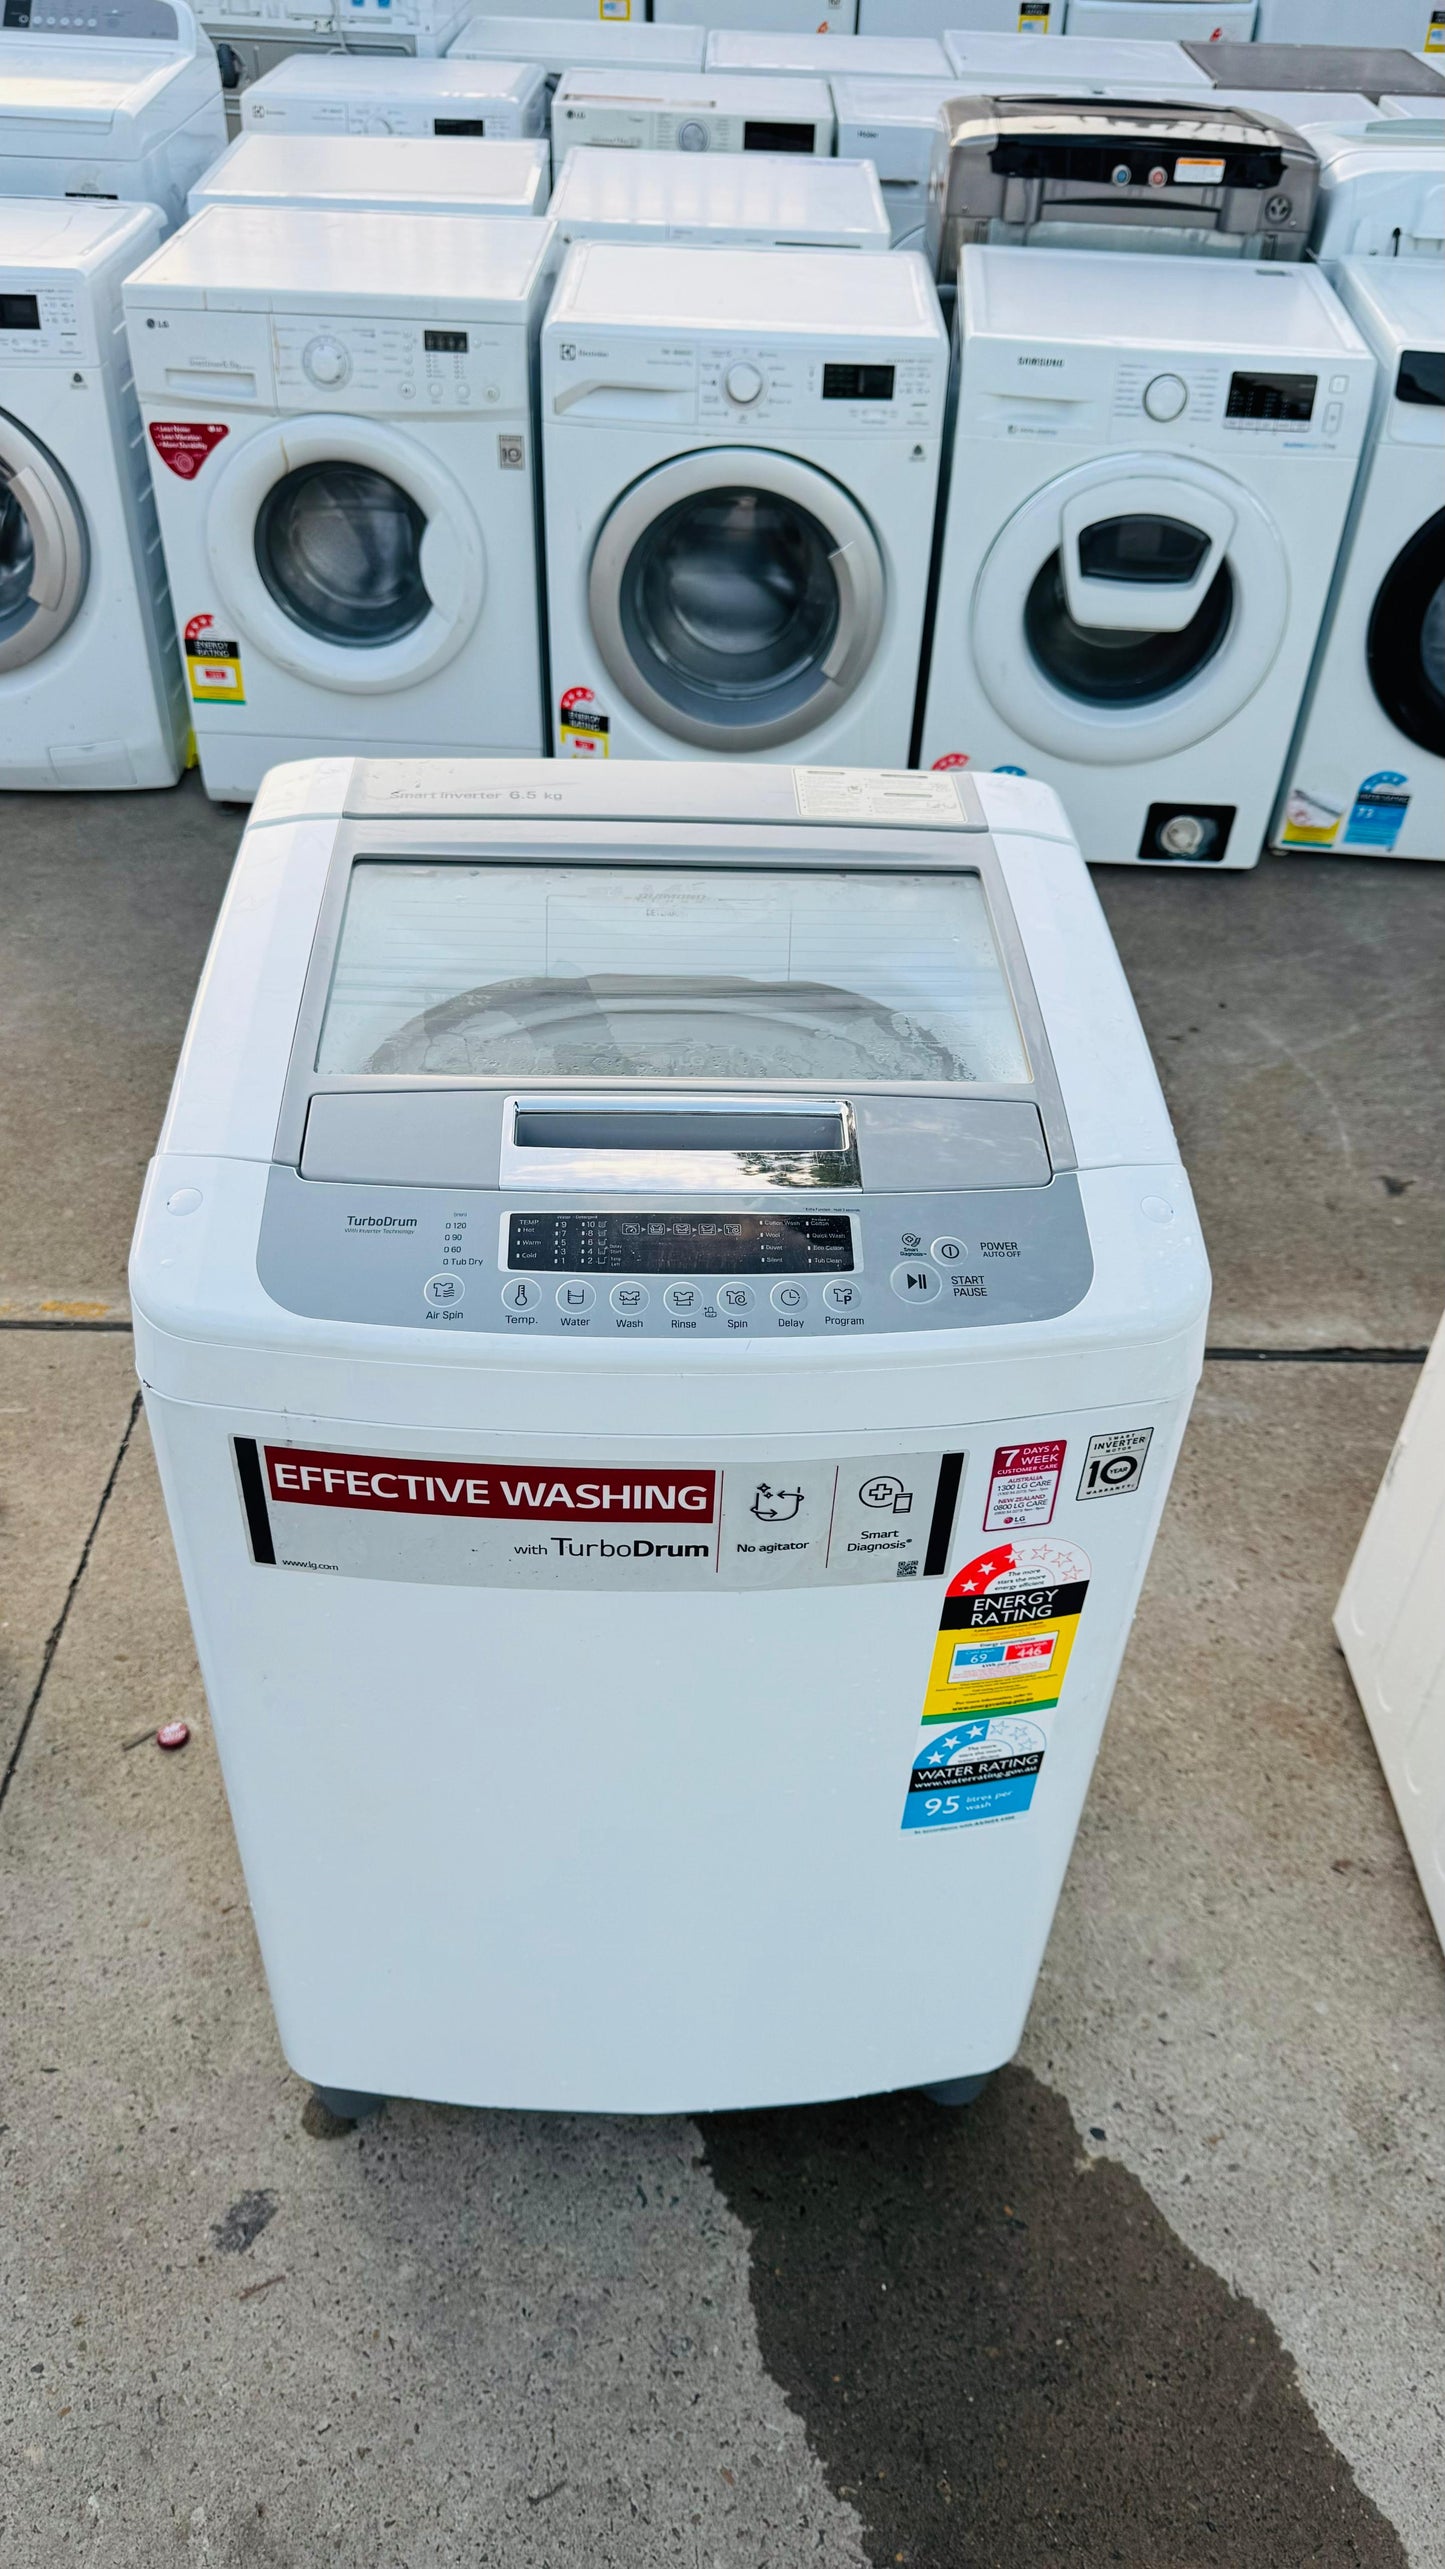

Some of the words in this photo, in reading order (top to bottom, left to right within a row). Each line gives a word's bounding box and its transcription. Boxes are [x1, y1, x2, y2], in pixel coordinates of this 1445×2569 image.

[390, 791, 437, 799] Smart
[441, 791, 502, 799] Inverter
[509, 791, 537, 799] 6.5
[544, 792, 563, 800] kg
[347, 1216, 418, 1227] TurboDrum
[980, 1242, 1018, 1250] POWER
[468, 1258, 483, 1267] Dry
[951, 1276, 985, 1285] START
[954, 1288, 988, 1296] PAUSE
[442, 1311, 463, 1320] Spin
[505, 1315, 538, 1324] Temp.
[560, 1318, 590, 1326] Water
[616, 1319, 643, 1328] Wash
[671, 1320, 696, 1328] Rinse
[727, 1320, 748, 1329] Spin
[778, 1318, 804, 1328] Delay
[825, 1316, 865, 1327] Program
[1094, 1437, 1145, 1450] INVERTER
[1023, 1446, 1050, 1454] DAYS
[1001, 1448, 1020, 1467] 7
[1021, 1454, 1059, 1465] WEEK
[997, 1466, 1037, 1475] CUSTOMER
[1088, 1456, 1137, 1488] 10
[274, 1463, 491, 1505] EFFECTIVE
[501, 1480, 708, 1512] WASHING
[1030, 1480, 1052, 1488] CARE
[1015, 1494, 1045, 1502] ZEALAND
[1026, 1499, 1048, 1507] CARE
[861, 1529, 900, 1540] Smart
[514, 1543, 548, 1557] with
[551, 1537, 710, 1558] TurboDrum
[737, 1543, 756, 1553] No
[758, 1541, 810, 1555] agitator
[282, 1559, 339, 1571] www.lg.com
[973, 1589, 1059, 1611] ENERGY
[971, 1605, 1053, 1626] RATING
[1017, 1648, 1043, 1658] 446
[970, 1654, 988, 1663] 69
[918, 1765, 974, 1780] WATER
[979, 1755, 1039, 1774] RATING
[966, 1795, 992, 1803] litres
[995, 1790, 1014, 1800] per
[924, 1795, 961, 1816] 95
[966, 1802, 992, 1812] wash
